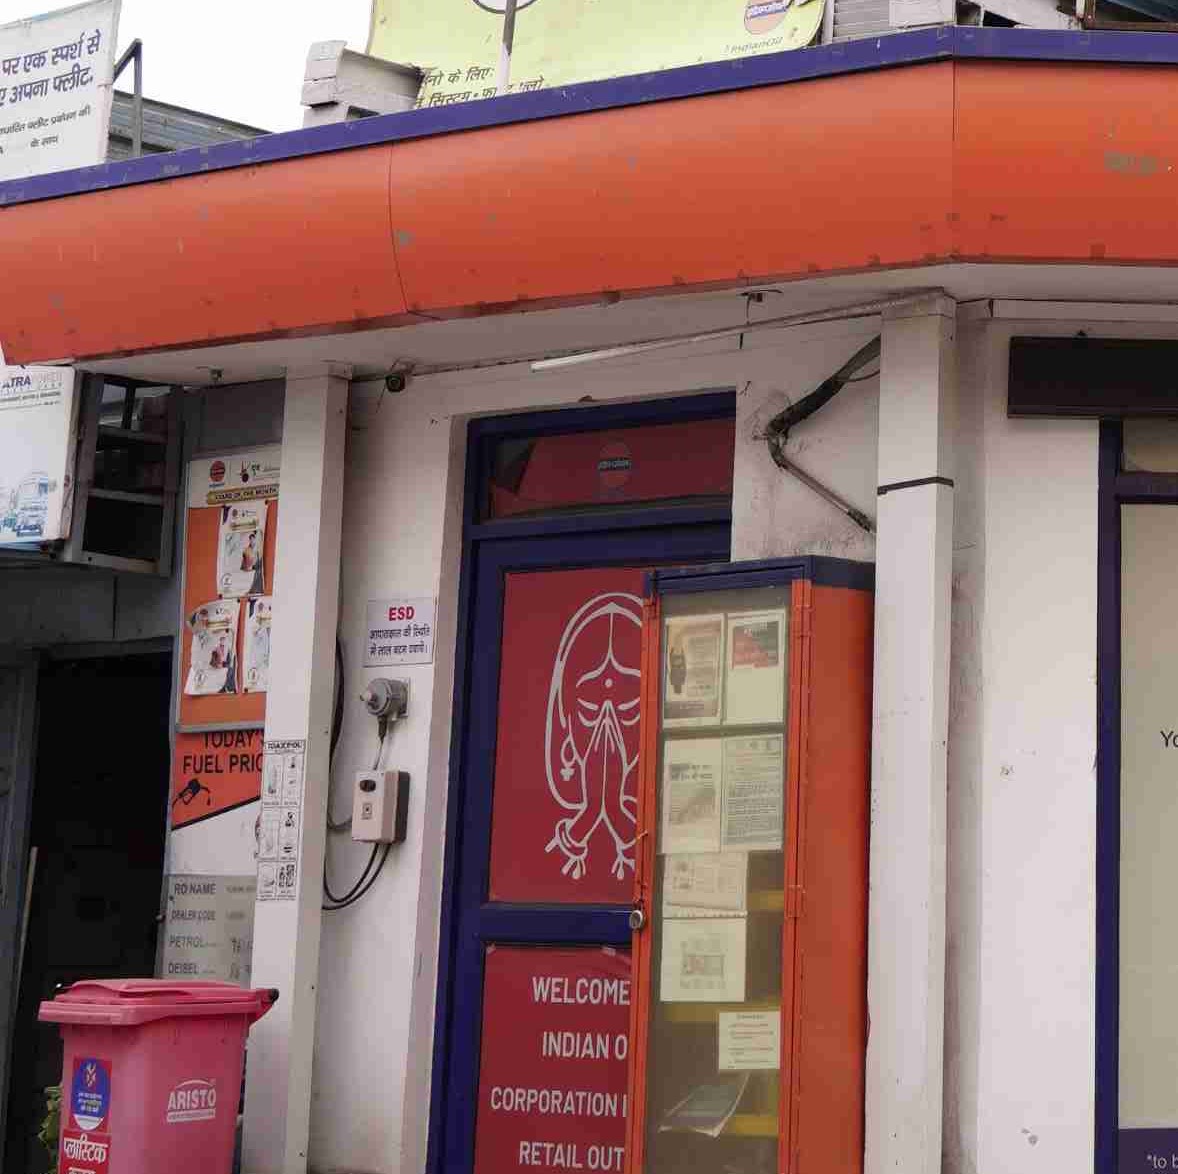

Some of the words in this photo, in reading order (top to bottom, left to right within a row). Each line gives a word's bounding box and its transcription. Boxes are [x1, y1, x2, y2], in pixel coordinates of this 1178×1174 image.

[2, 57, 21, 75] पर
[23, 50, 48, 73] एक
[51, 32, 85, 65] स्पर्श
[87, 29, 101, 54] से
[9, 79, 50, 103] अपना
[389, 606, 415, 621] ESD
[183, 755, 224, 774] FUEL
[188, 883, 216, 895] NAME
[532, 976, 631, 1006] WELCOME
[542, 1031, 609, 1060] INDIAN
[168, 1088, 216, 1110] ARISTO
[490, 1086, 617, 1118] CORPORATION
[64, 1133, 108, 1165] प्लास्टिक
[519, 1140, 583, 1169] RETAIL
